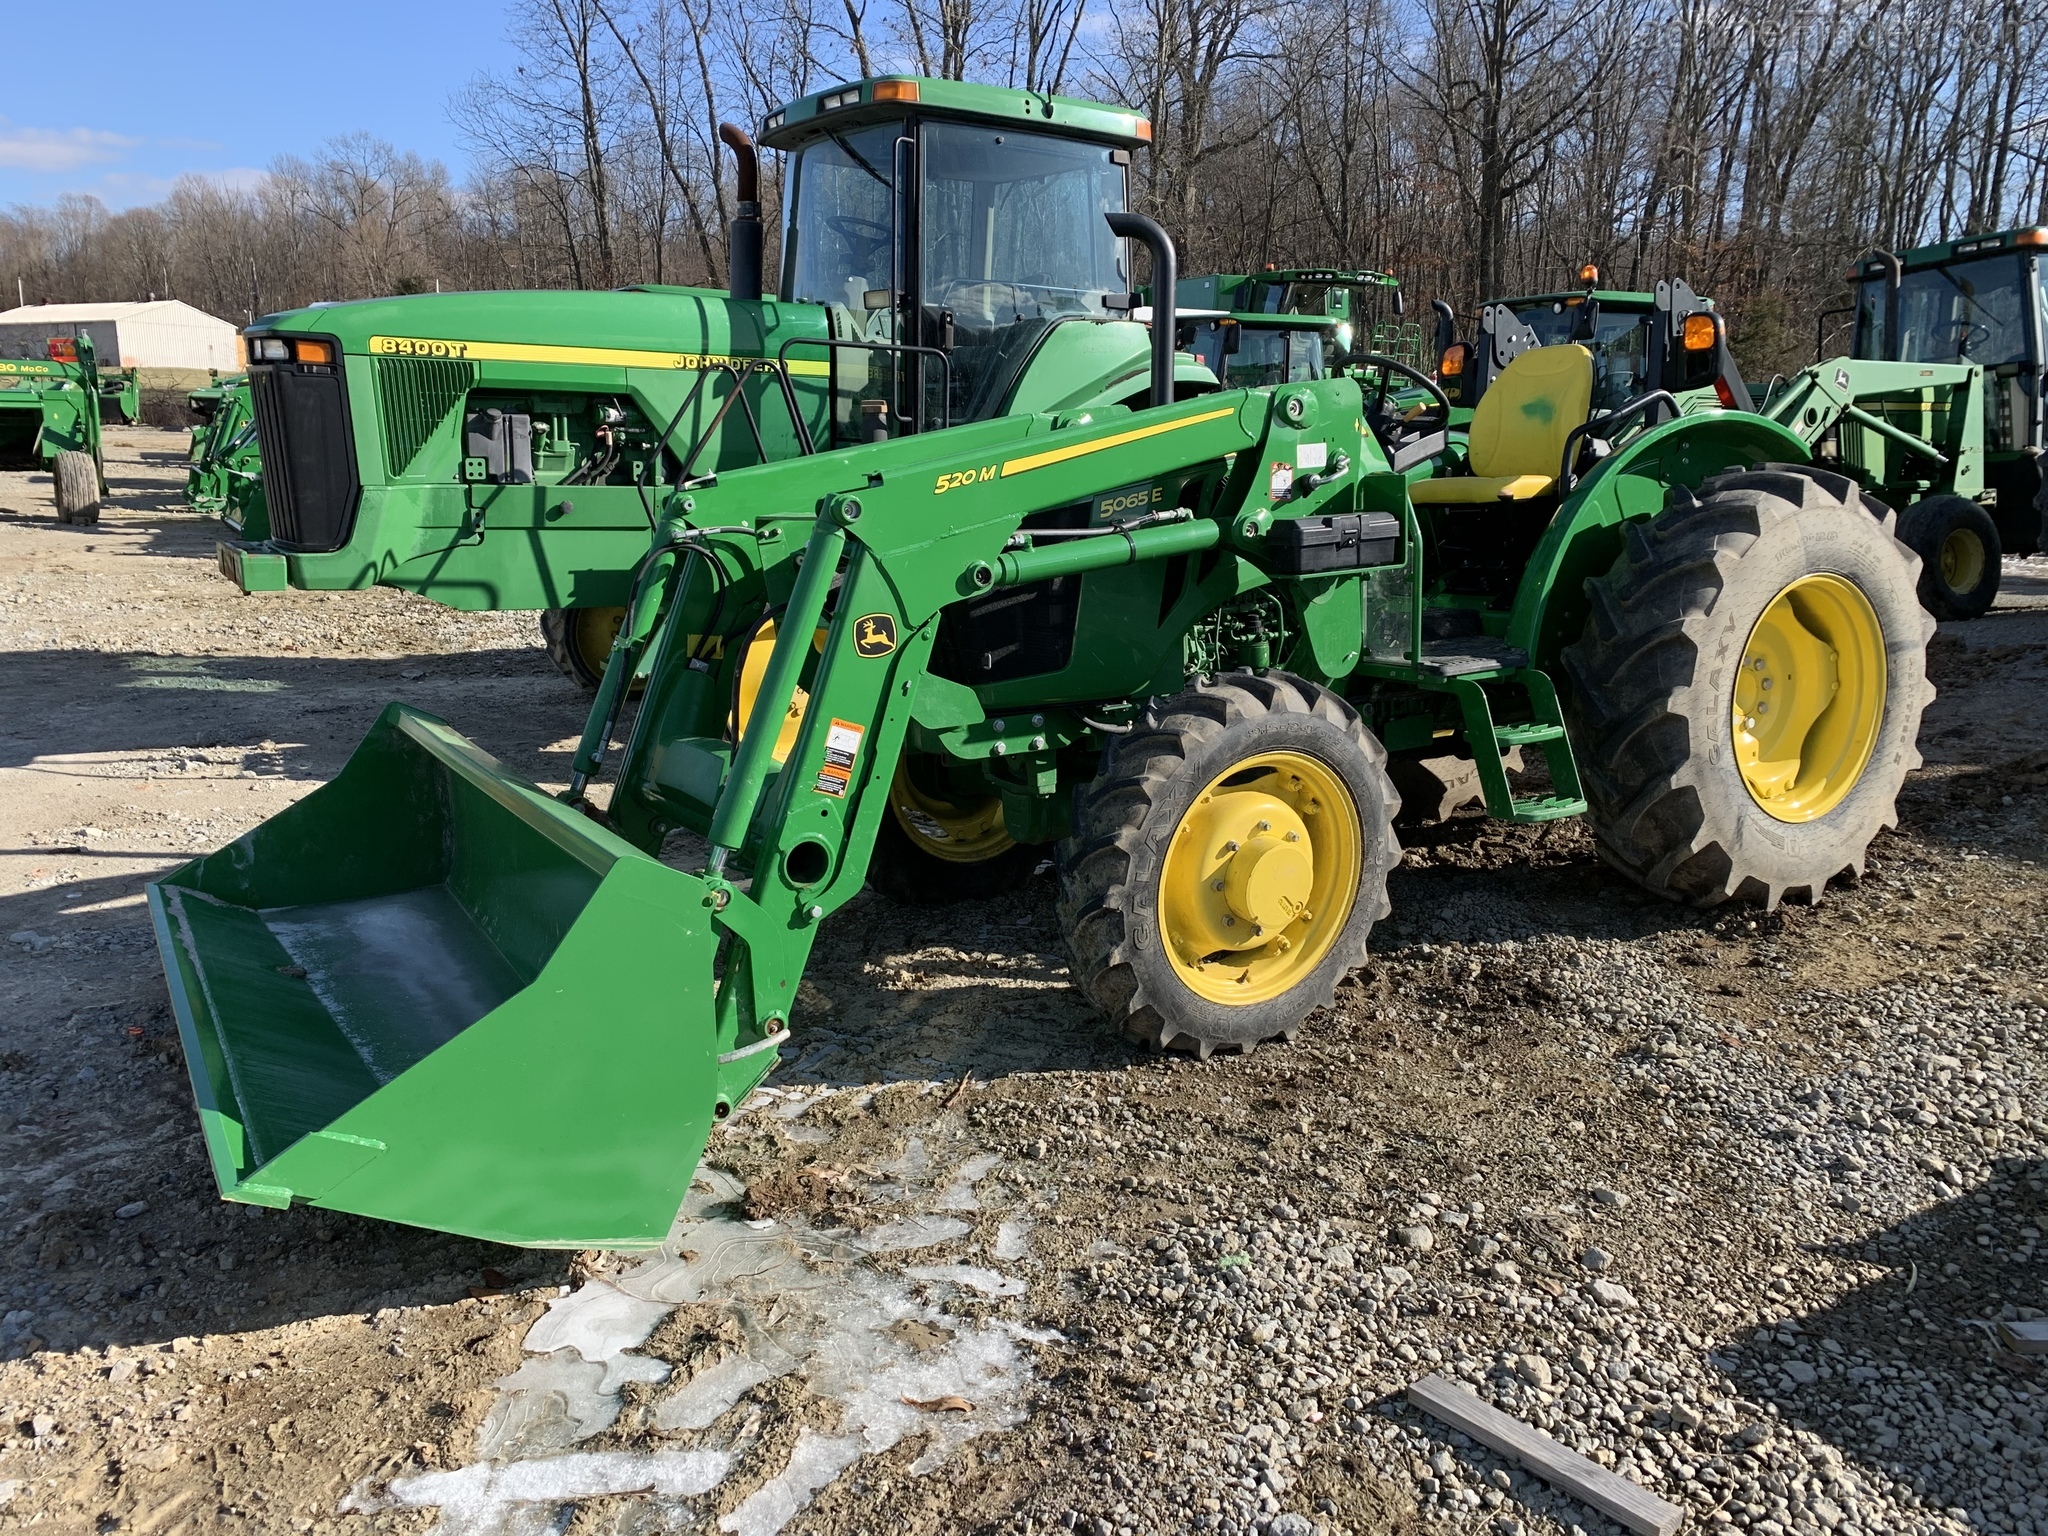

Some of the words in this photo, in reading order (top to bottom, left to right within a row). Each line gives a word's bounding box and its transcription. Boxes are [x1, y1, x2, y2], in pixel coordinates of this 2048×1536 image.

[381, 338, 468, 358] 8400T
[20, 365, 49, 373] MoCo
[933, 469, 977, 495] 520
[978, 464, 997, 483] M
[1100, 490, 1149, 518] 5065
[1151, 487, 1163, 503] E
[1706, 611, 1737, 766] GALAXY
[1131, 757, 1203, 951] GALAXY
